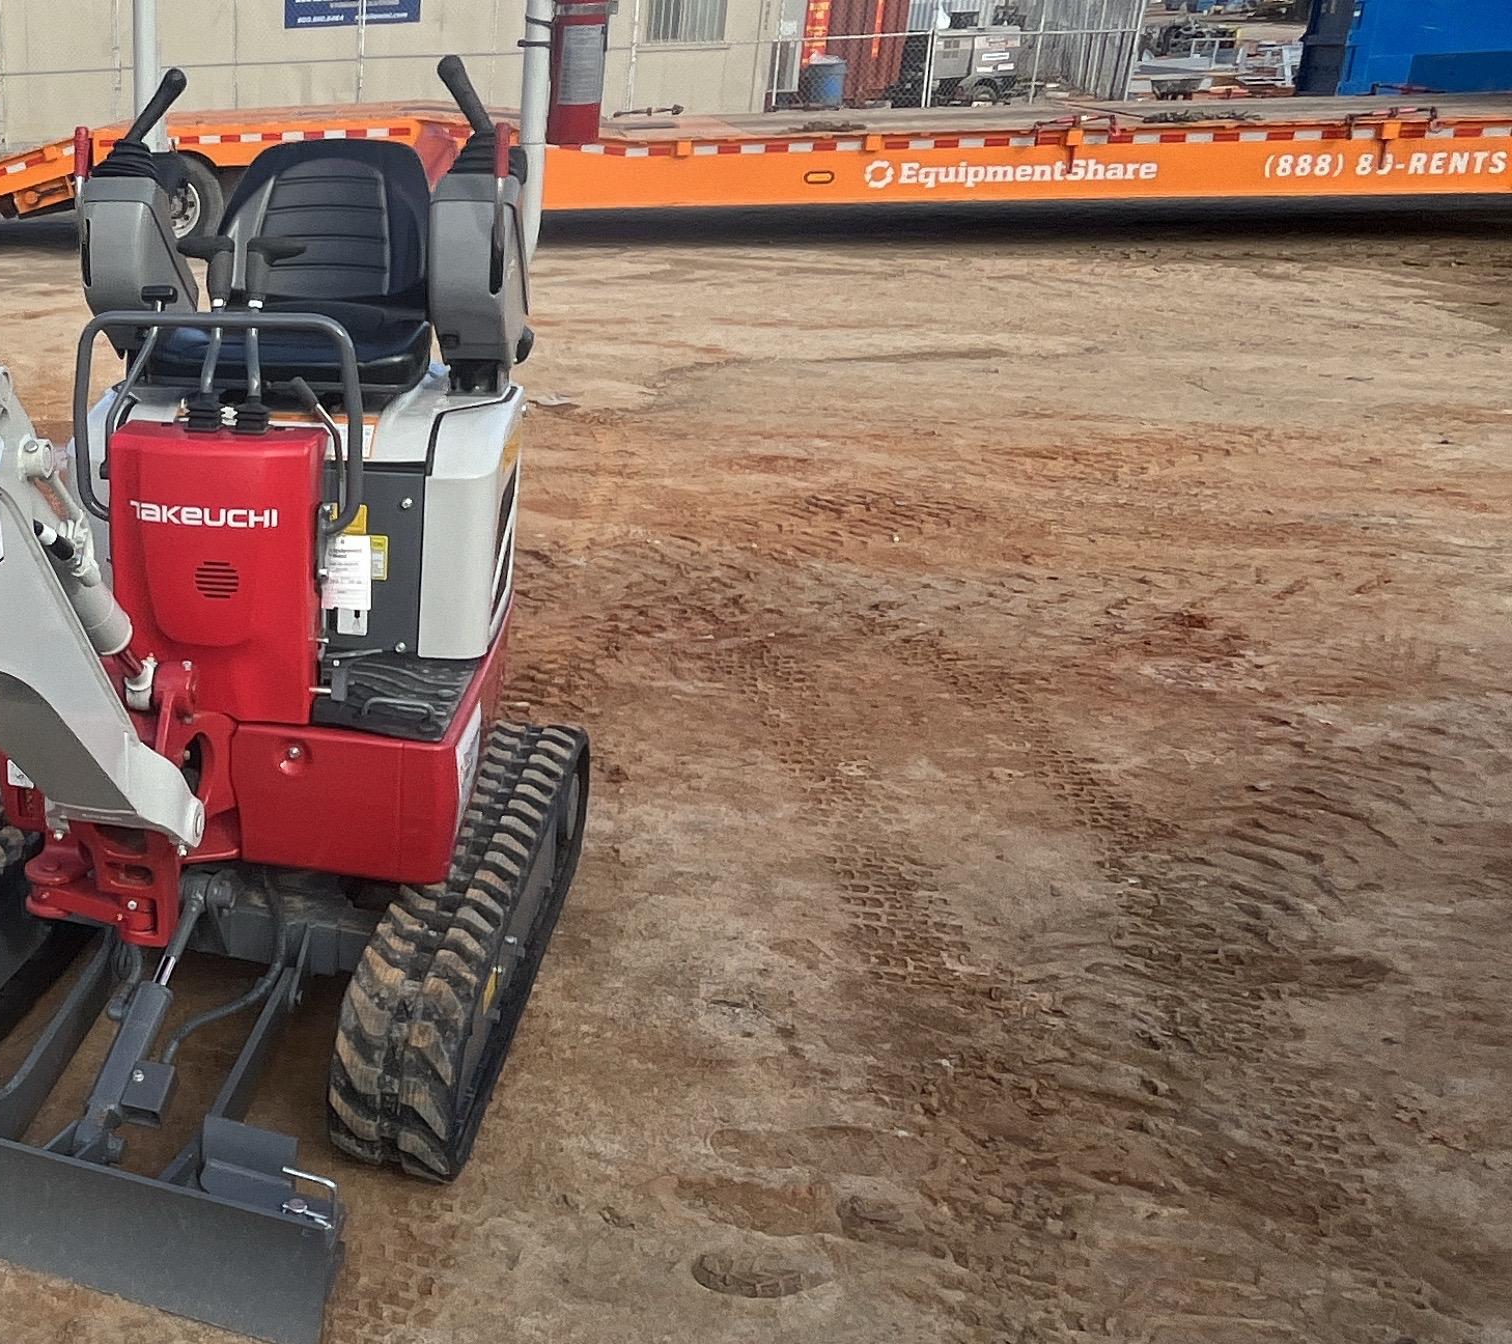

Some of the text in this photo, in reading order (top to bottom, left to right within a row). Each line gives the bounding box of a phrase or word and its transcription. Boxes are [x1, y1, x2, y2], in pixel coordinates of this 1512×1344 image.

[898, 159, 1158, 189] EquipmentShare
[1264, 153, 1344, 178] (888)
[129, 499, 279, 529] TAKEUCHI
